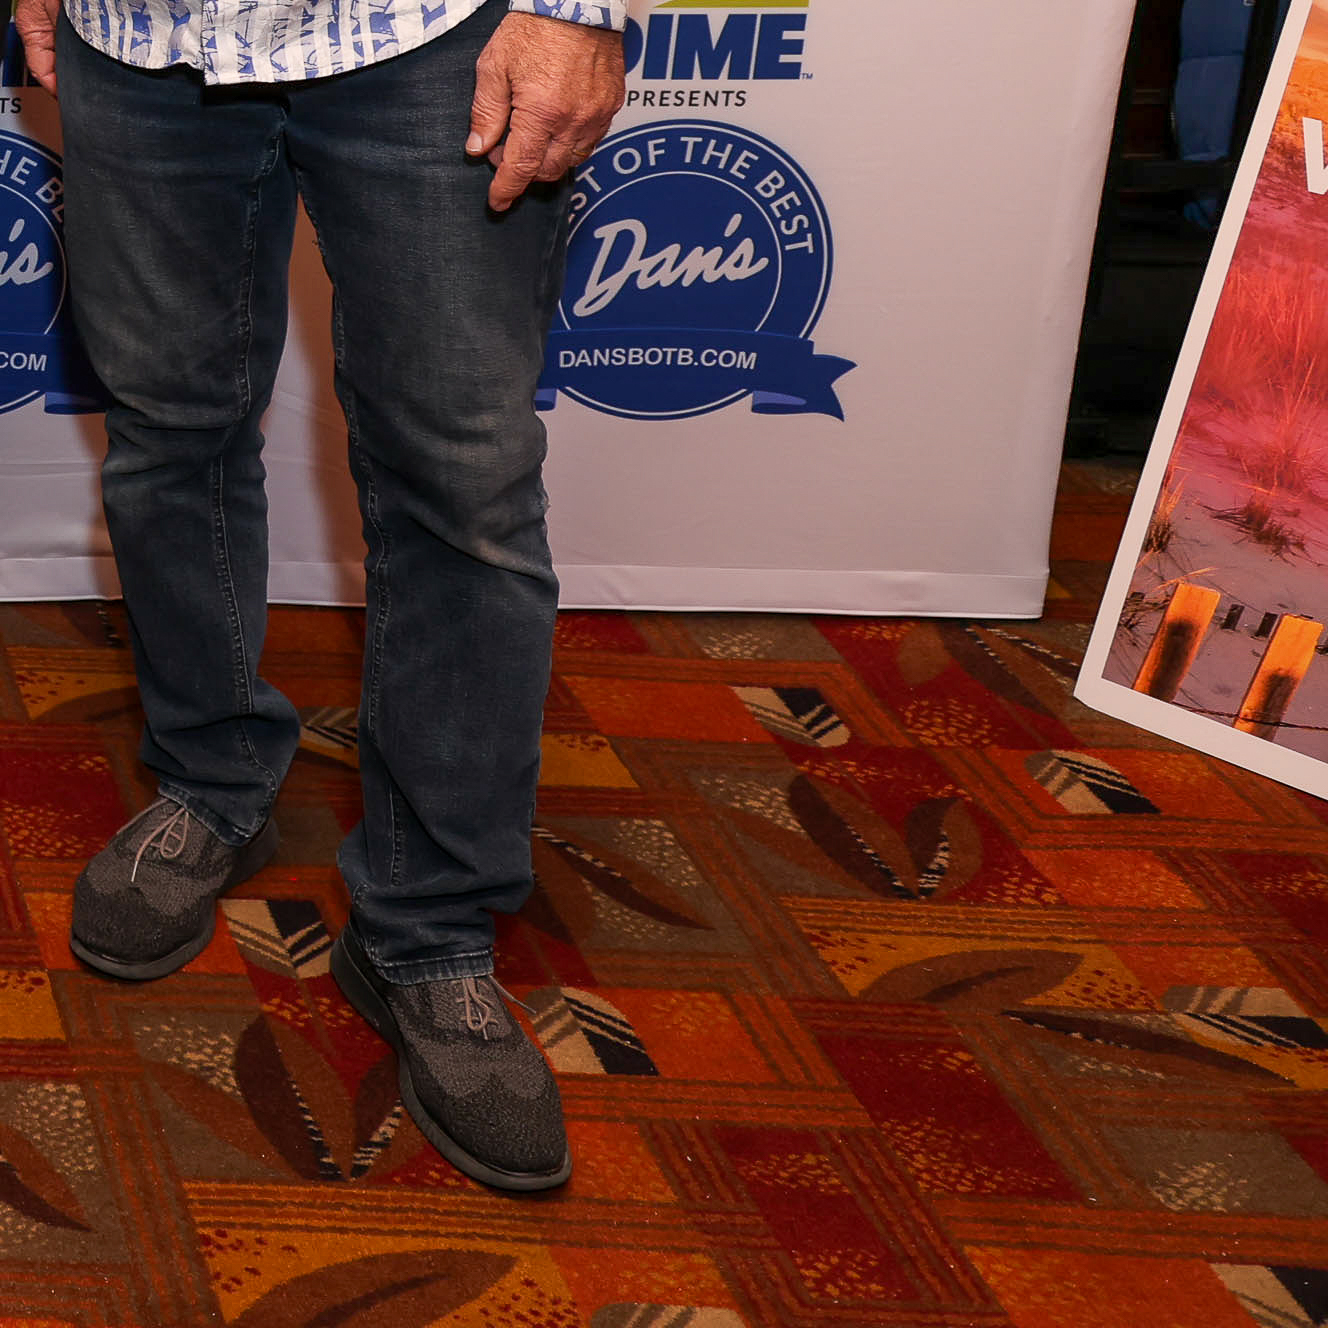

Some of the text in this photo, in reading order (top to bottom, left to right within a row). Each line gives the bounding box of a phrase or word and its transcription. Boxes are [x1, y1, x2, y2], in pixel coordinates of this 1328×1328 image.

[626, 90, 748, 108] PRESENTS
[612, 137, 667, 176] OF
[680, 136, 759, 180] THE
[754, 169, 814, 255] BEST
[572, 213, 769, 318] Dan's
[559, 347, 757, 371] DANSBOTB.COM
